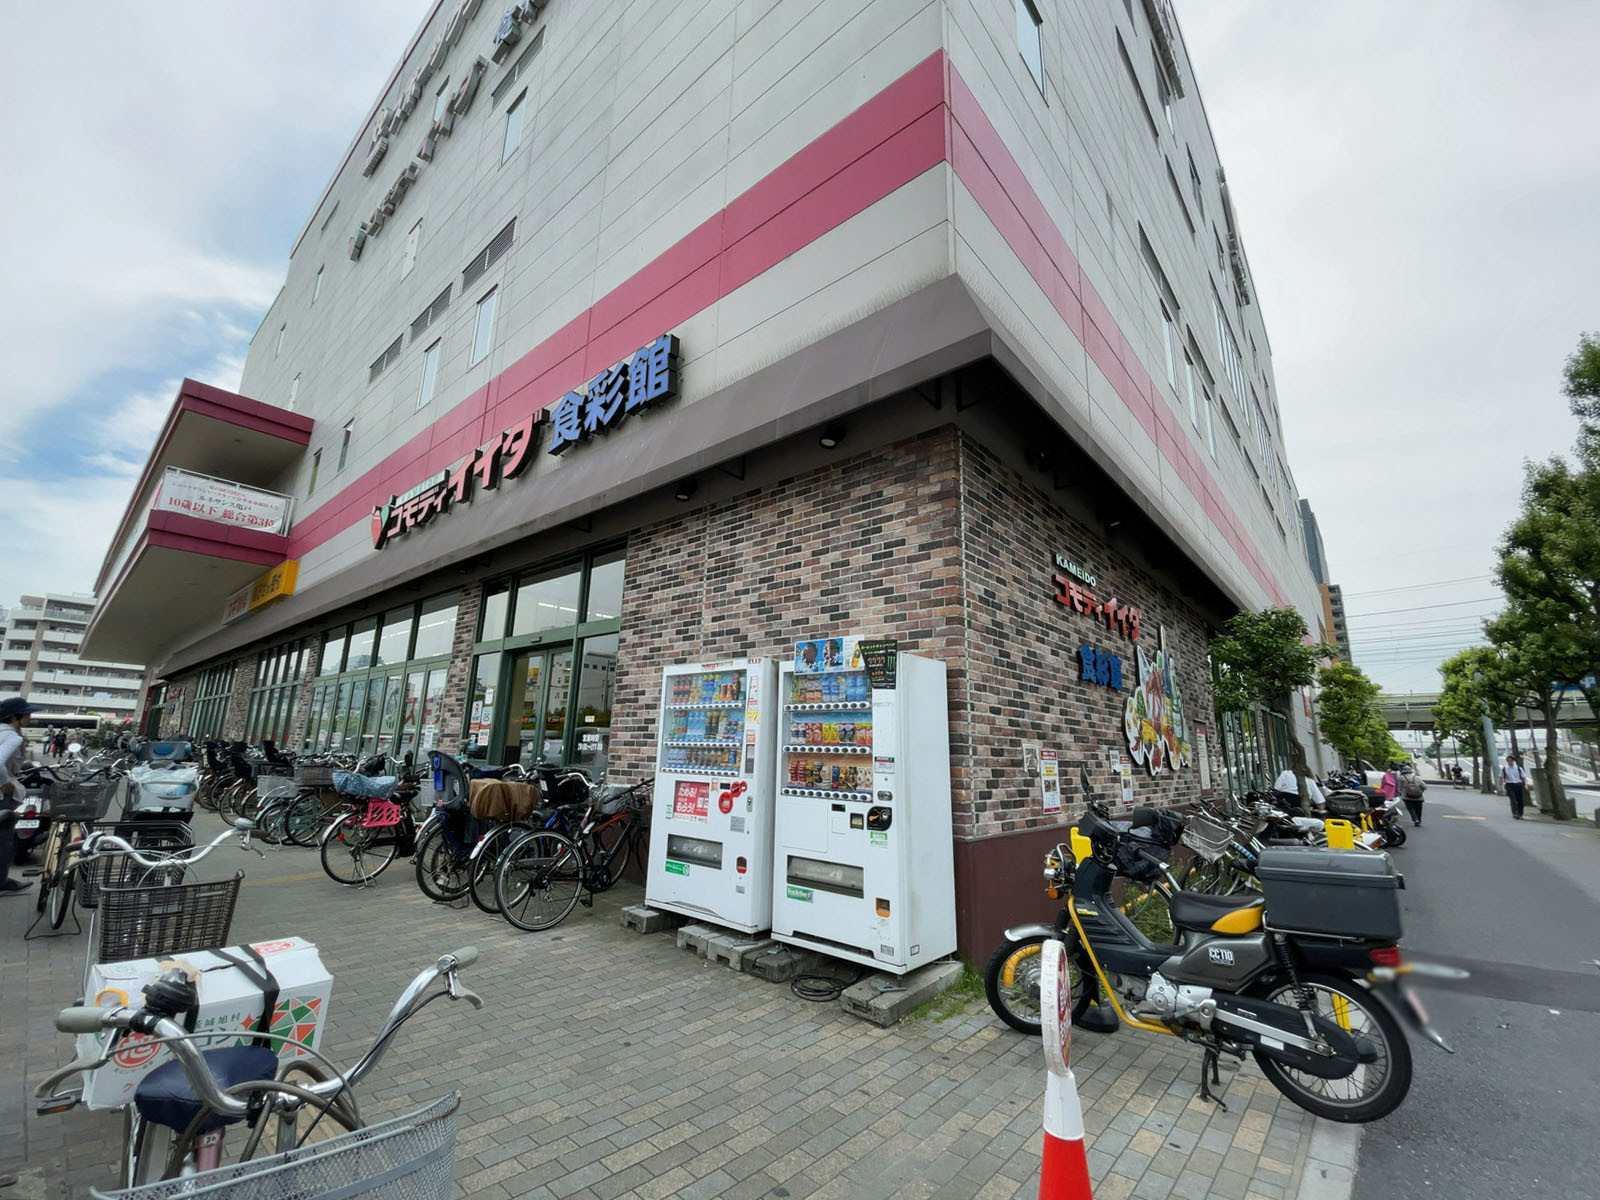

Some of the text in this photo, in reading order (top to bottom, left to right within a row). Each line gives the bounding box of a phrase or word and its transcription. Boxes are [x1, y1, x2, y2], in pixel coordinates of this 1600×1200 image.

[386, 334, 673, 538] コモディイイダ 食彩館
[169, 496, 218, 516] 10歳以下
[1055, 553, 1097, 587] KAMEIDO
[1055, 573, 1141, 640] コモディイイダ
[1209, 948, 1234, 961] CC110
